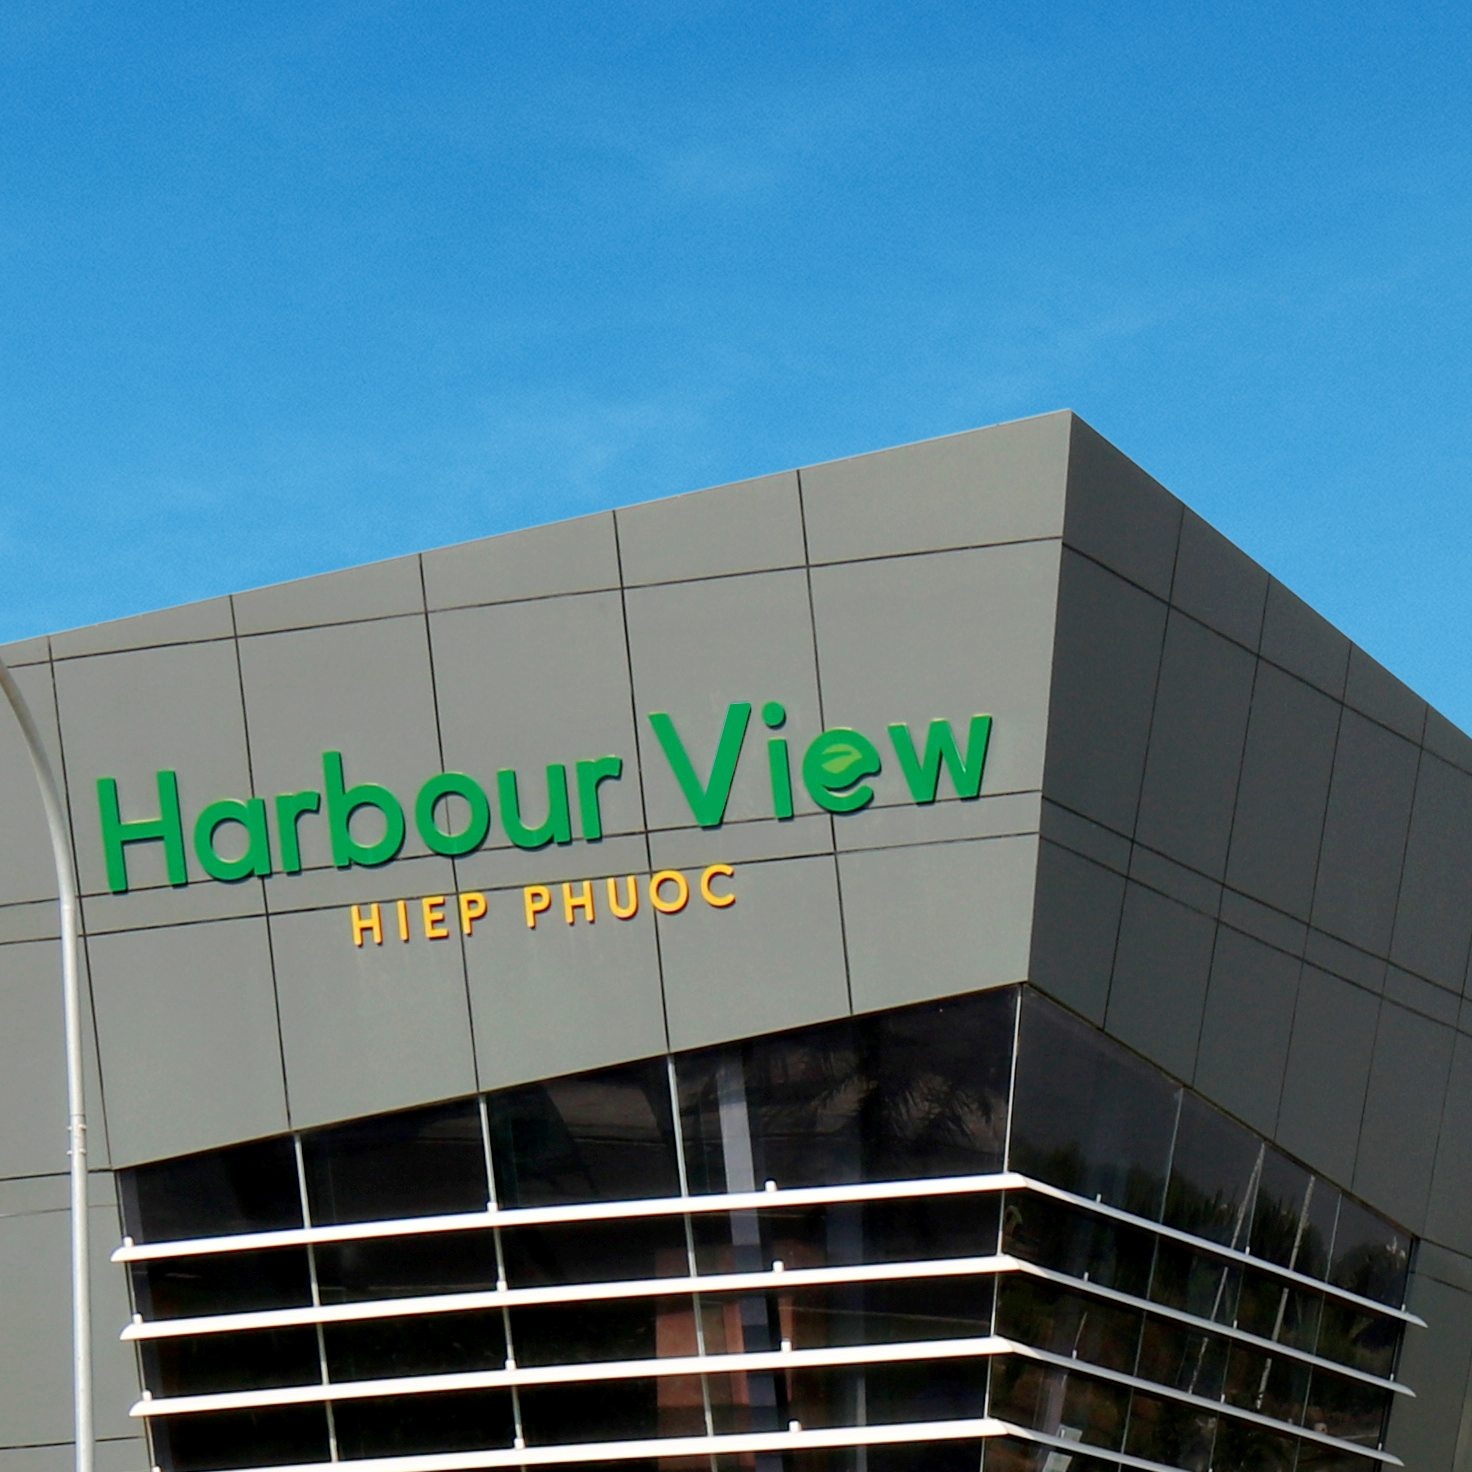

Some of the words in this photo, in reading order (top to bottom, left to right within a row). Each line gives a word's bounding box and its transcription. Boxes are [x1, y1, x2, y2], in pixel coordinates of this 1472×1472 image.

[96, 750, 624, 894] Harbour
[648, 701, 994, 829] View
[350, 890, 489, 947] HIEP
[522, 862, 738, 929] PHUOC
